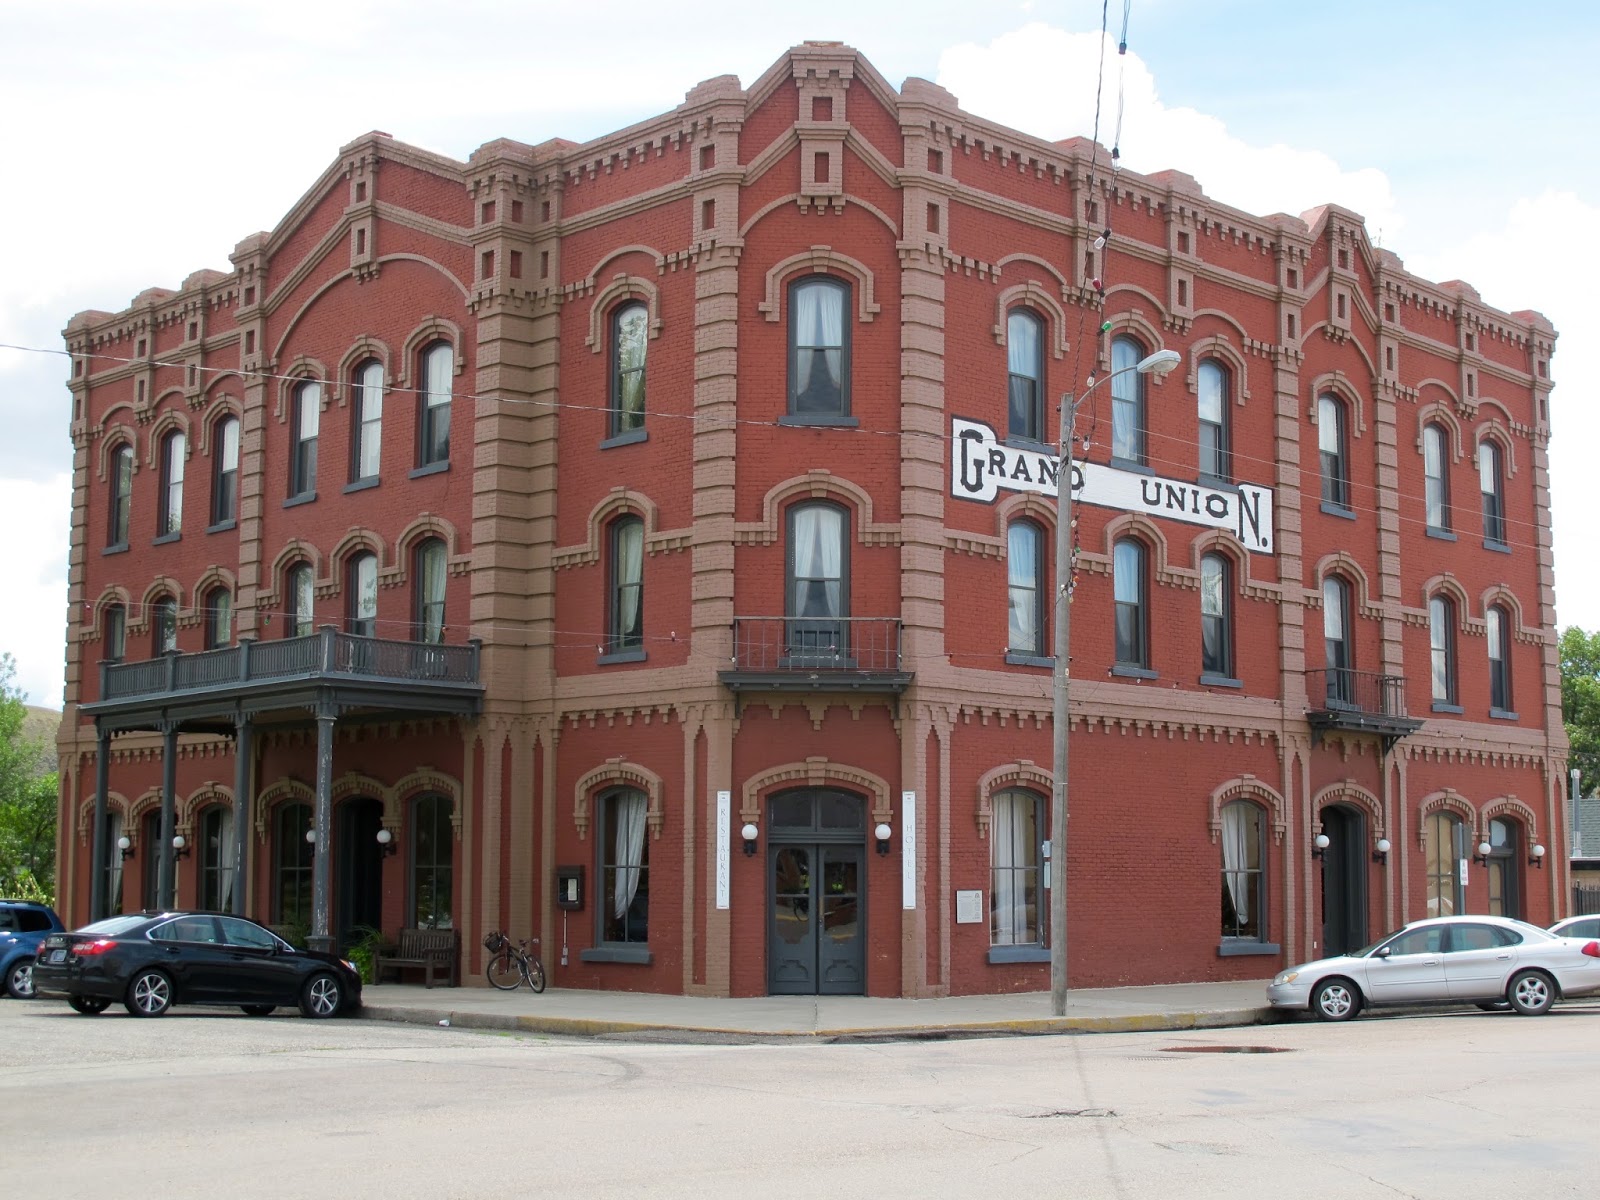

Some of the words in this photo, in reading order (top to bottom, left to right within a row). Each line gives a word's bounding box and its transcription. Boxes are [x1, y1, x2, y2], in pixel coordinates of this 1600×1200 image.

[959, 429, 1085, 492] GRAND
[1140, 479, 1268, 548] UNION.
[719, 808, 727, 898] RESTAURANT
[905, 824, 914, 880] HOTEL
